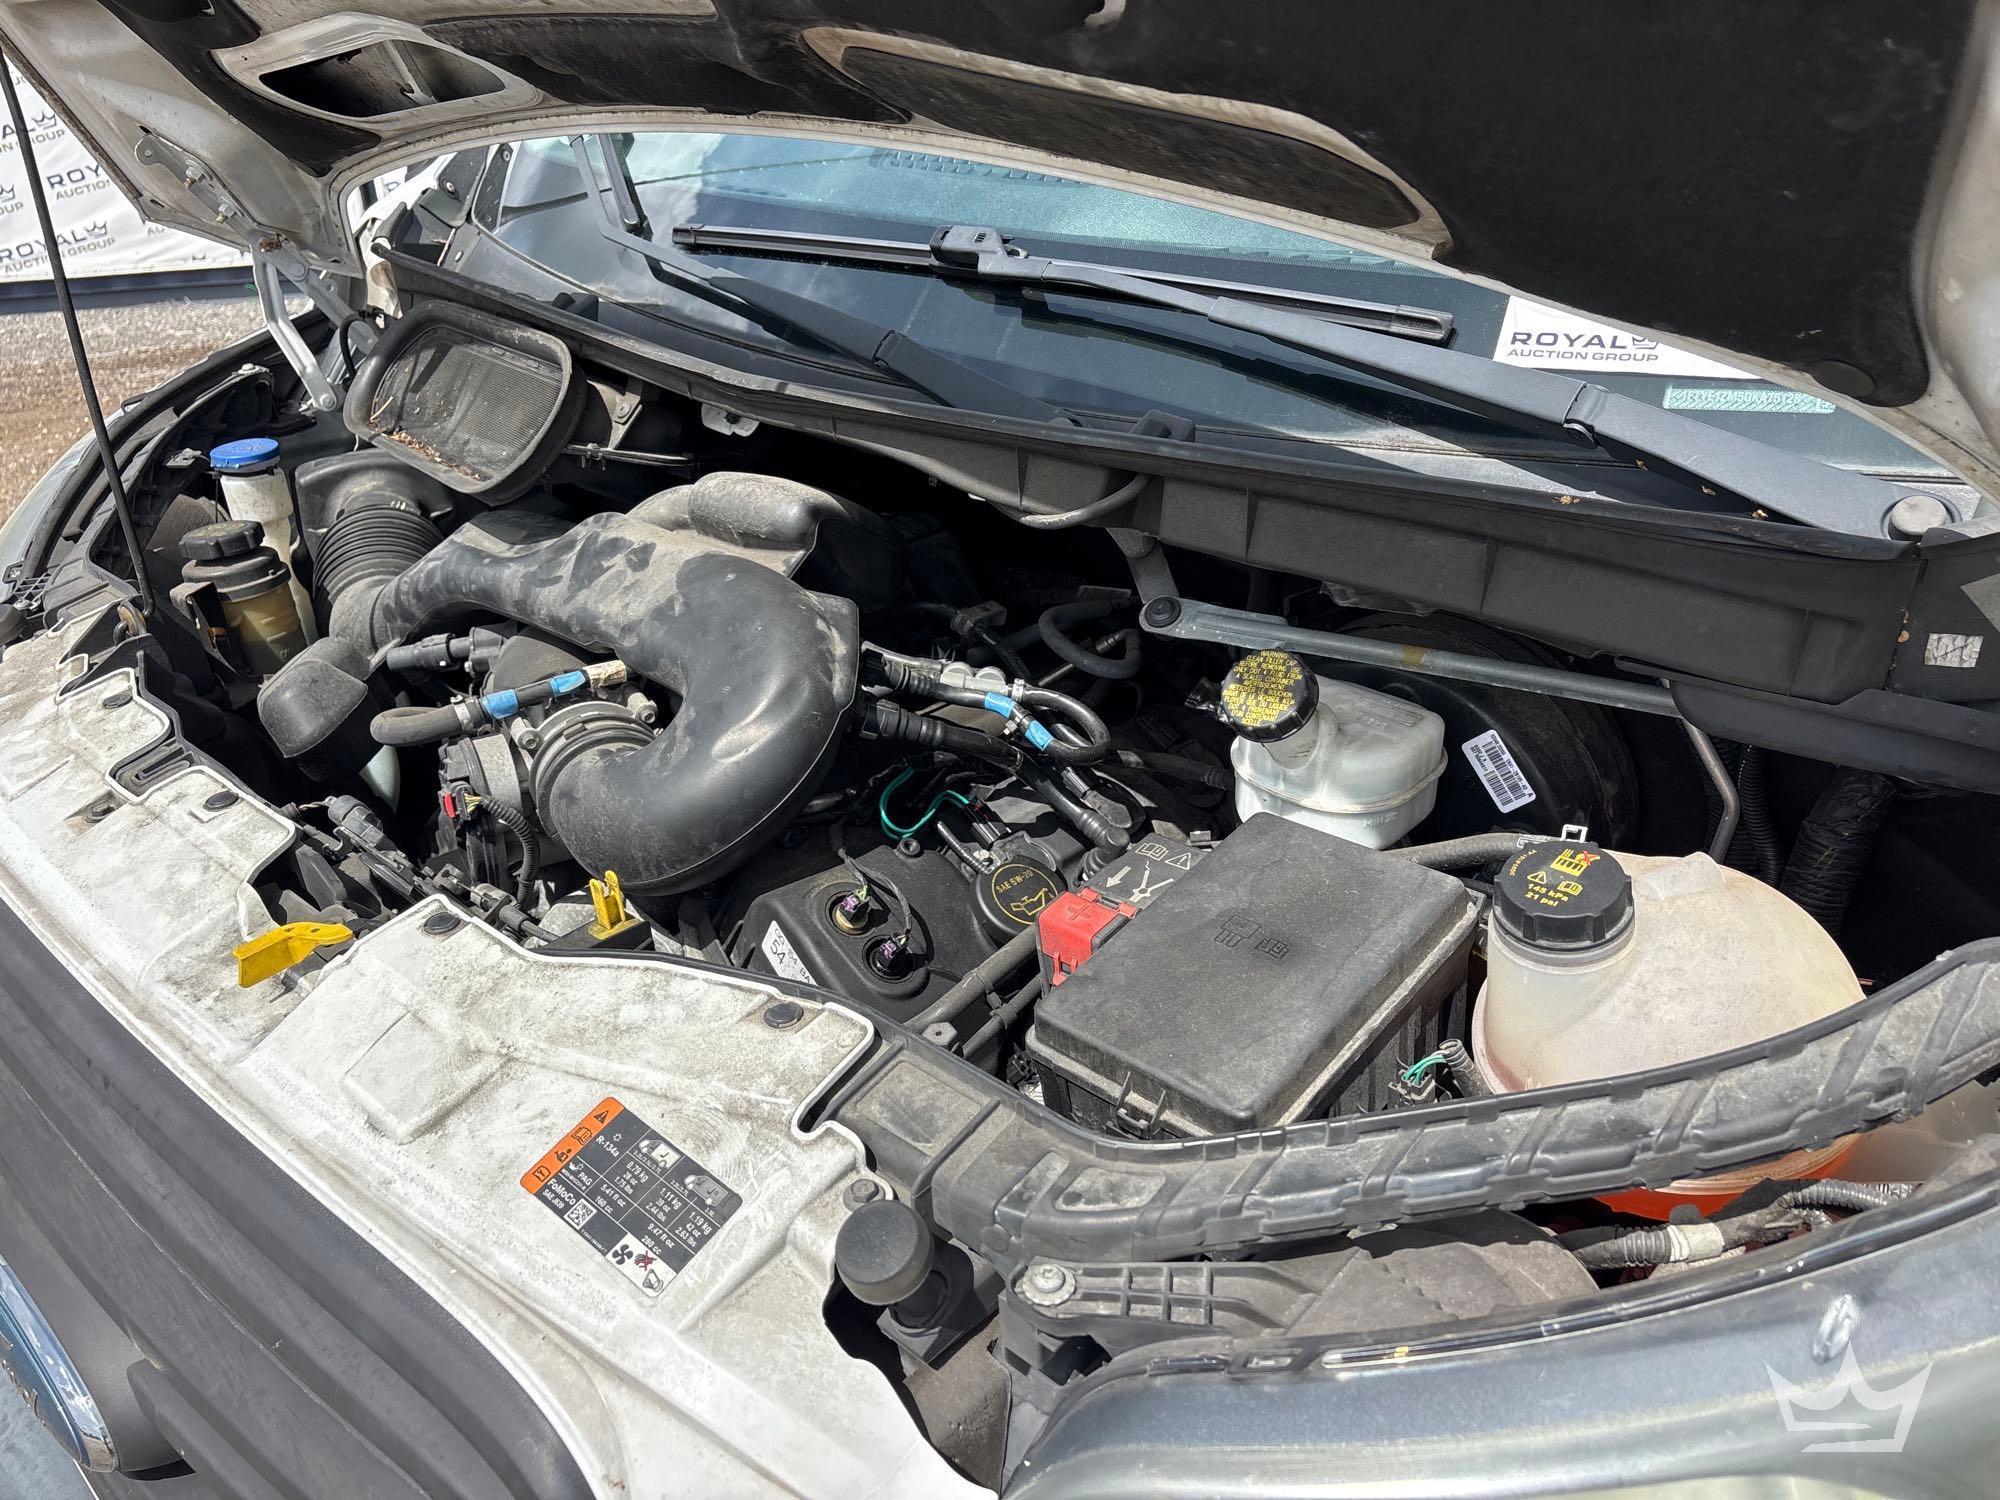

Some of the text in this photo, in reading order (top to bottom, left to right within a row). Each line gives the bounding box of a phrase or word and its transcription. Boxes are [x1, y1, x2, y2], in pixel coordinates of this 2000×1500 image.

[47, 164, 100, 189] ROY
[67, 237, 116, 257] GROUP
[1510, 331, 1627, 349] ROYAL
[1507, 349, 1659, 362] AUCTION GROUP
[996, 869, 1034, 893] SAE 5W-20
[1525, 891, 1559, 907] 21 psi
[1528, 883, 1569, 902] 145 kPa
[595, 1135, 620, 1158] R-134a
[577, 1171, 593, 1186] PAG
[622, 1171, 638, 1186] 28 oz
[626, 1161, 649, 1183] 0.79 kg
[542, 1188, 556, 1201] SAE
[547, 1178, 577, 1206] FoMoCo
[600, 1183, 627, 1208] 5.41 fl oz
[614, 1176, 634, 1195] 1.75 lbs
[595, 1195, 614, 1214] 160 cc
[655, 1197, 671, 1213] 39 oz
[660, 1187, 682, 1210] 1.11 kg
[645, 1202, 667, 1222] 2.44 lbs
[685, 1222, 701, 1238] 42 oz
[688, 1211, 713, 1236] 1.19 kg
[641, 1235, 662, 1255] 280 cc
[647, 1222, 676, 1249] 9.47 fl oz
[675, 1226, 697, 1248] 2.63 lbs
